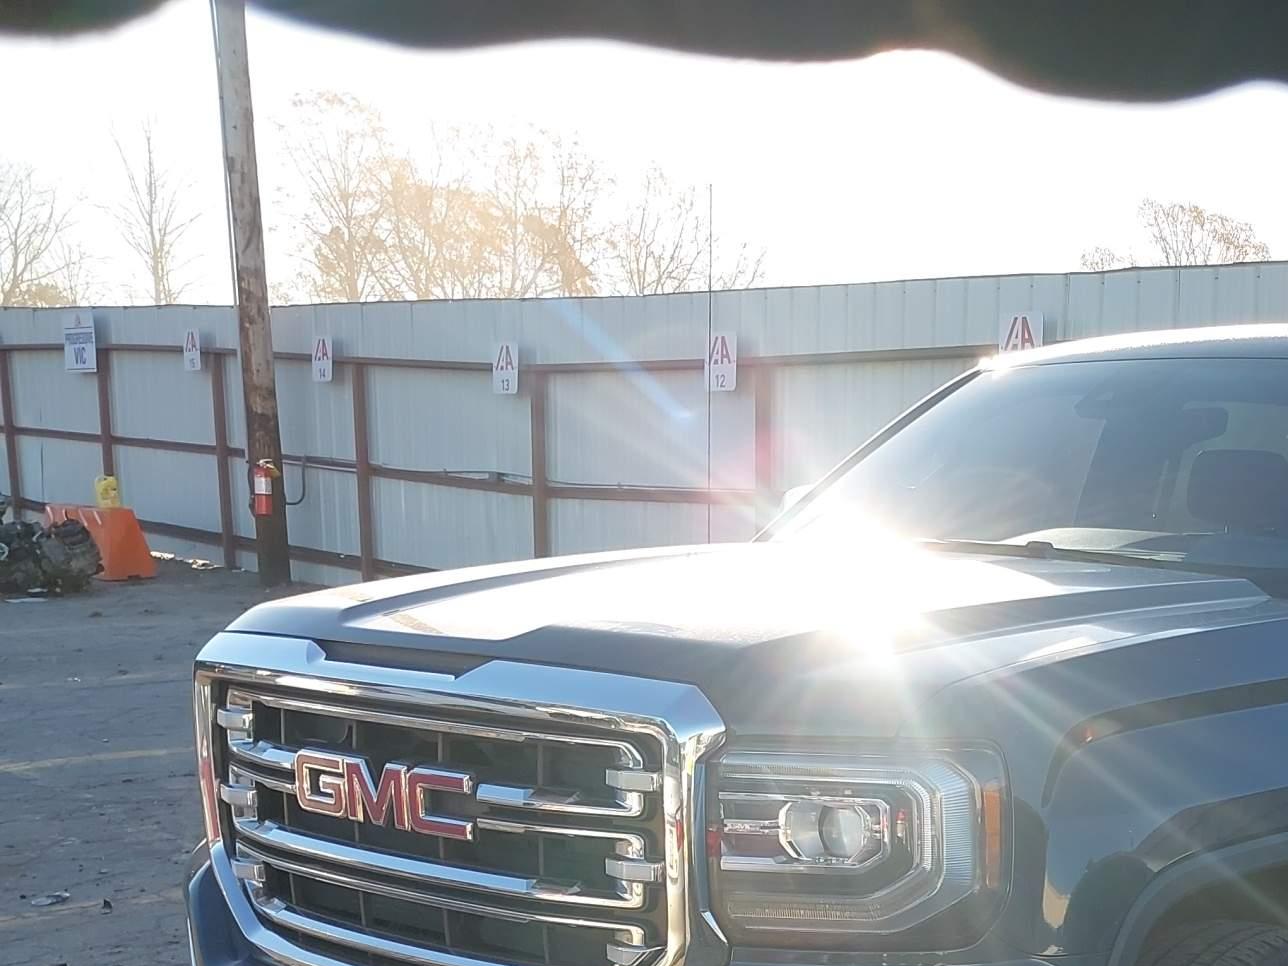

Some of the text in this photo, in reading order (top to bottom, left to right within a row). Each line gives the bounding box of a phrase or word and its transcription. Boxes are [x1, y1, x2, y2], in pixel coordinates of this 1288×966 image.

[73, 347, 87, 365] VIC
[319, 368, 326, 379] 14
[501, 379, 510, 391] 13
[715, 374, 726, 388] 12
[294, 748, 474, 841] GMC
